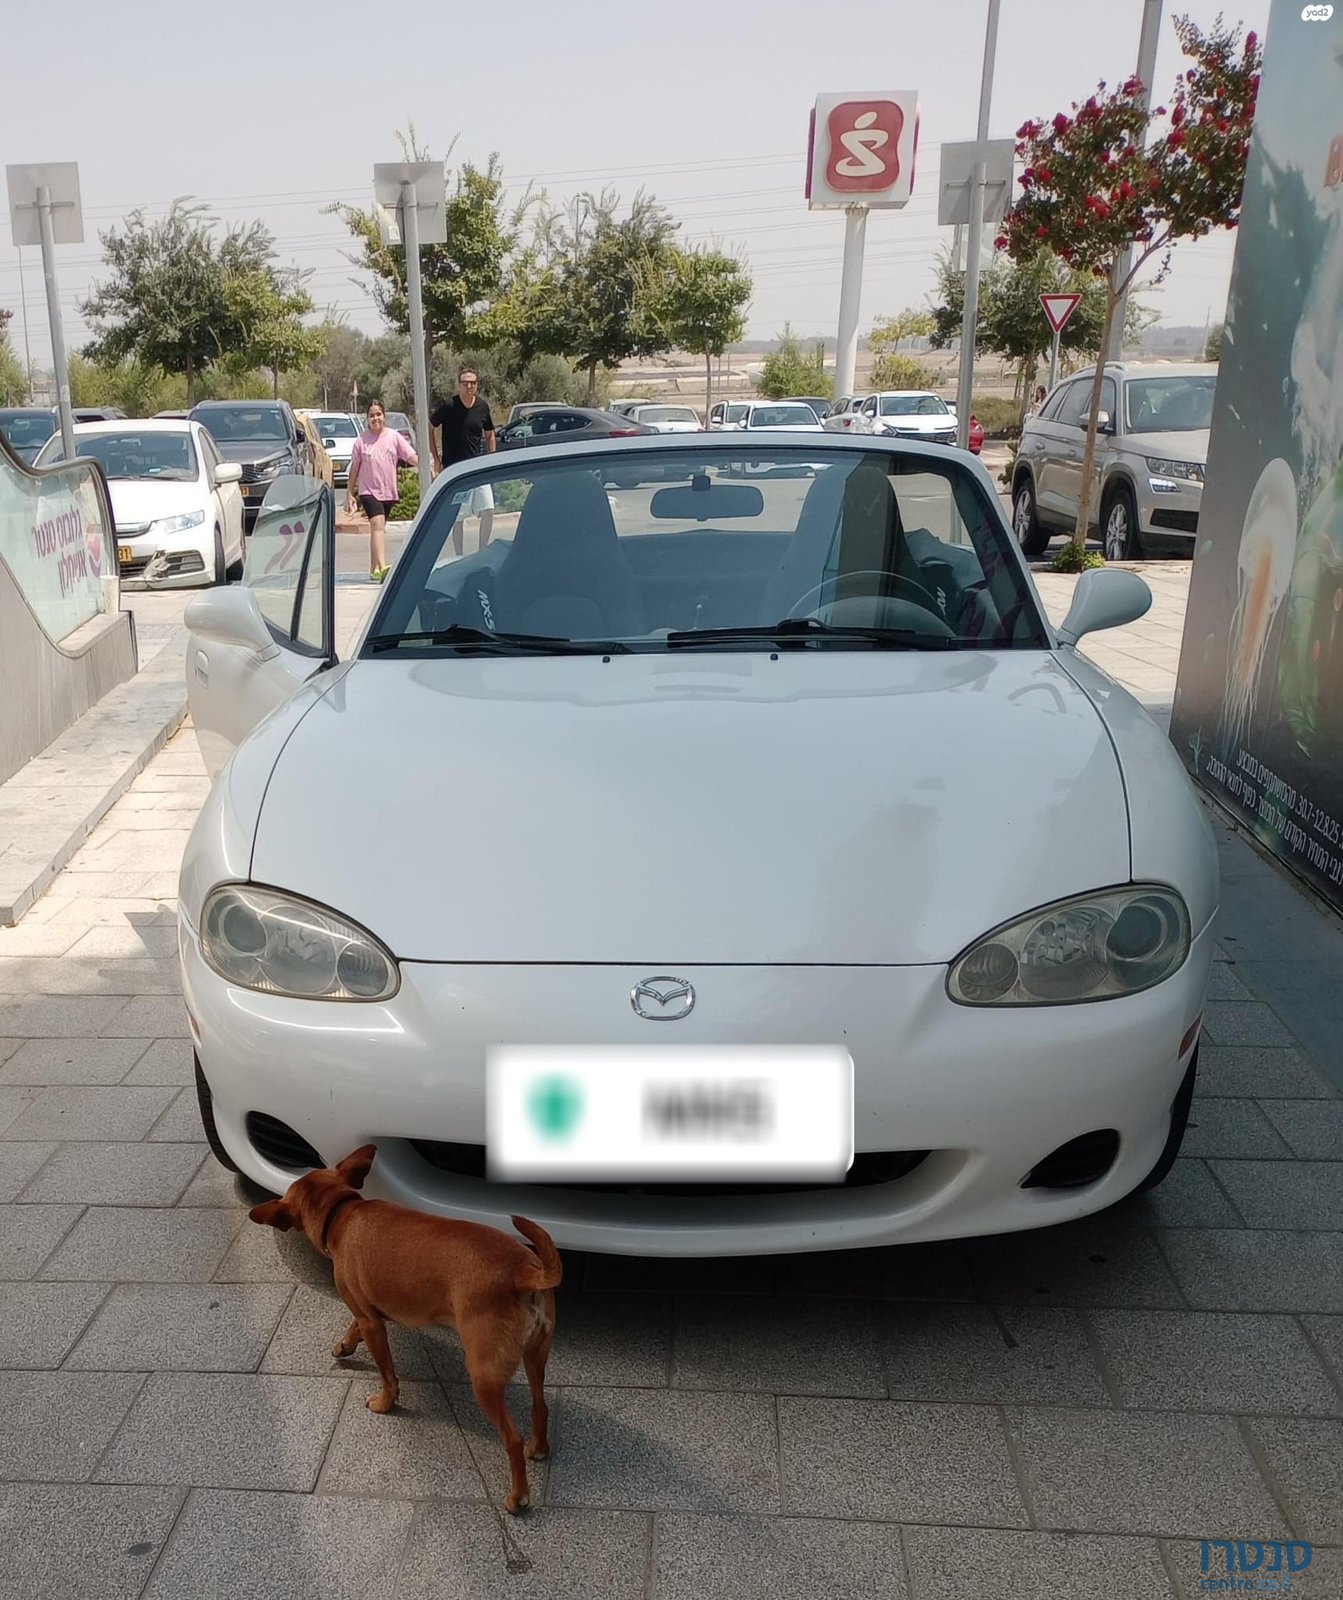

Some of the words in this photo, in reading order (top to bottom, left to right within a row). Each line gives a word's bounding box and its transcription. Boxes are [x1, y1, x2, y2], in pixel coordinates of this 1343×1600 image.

[31, 519, 57, 559] סנטר
[57, 548, 88, 599] אשקלון
[1274, 805, 1287, 834] של
[1284, 820, 1307, 853] הקודם
